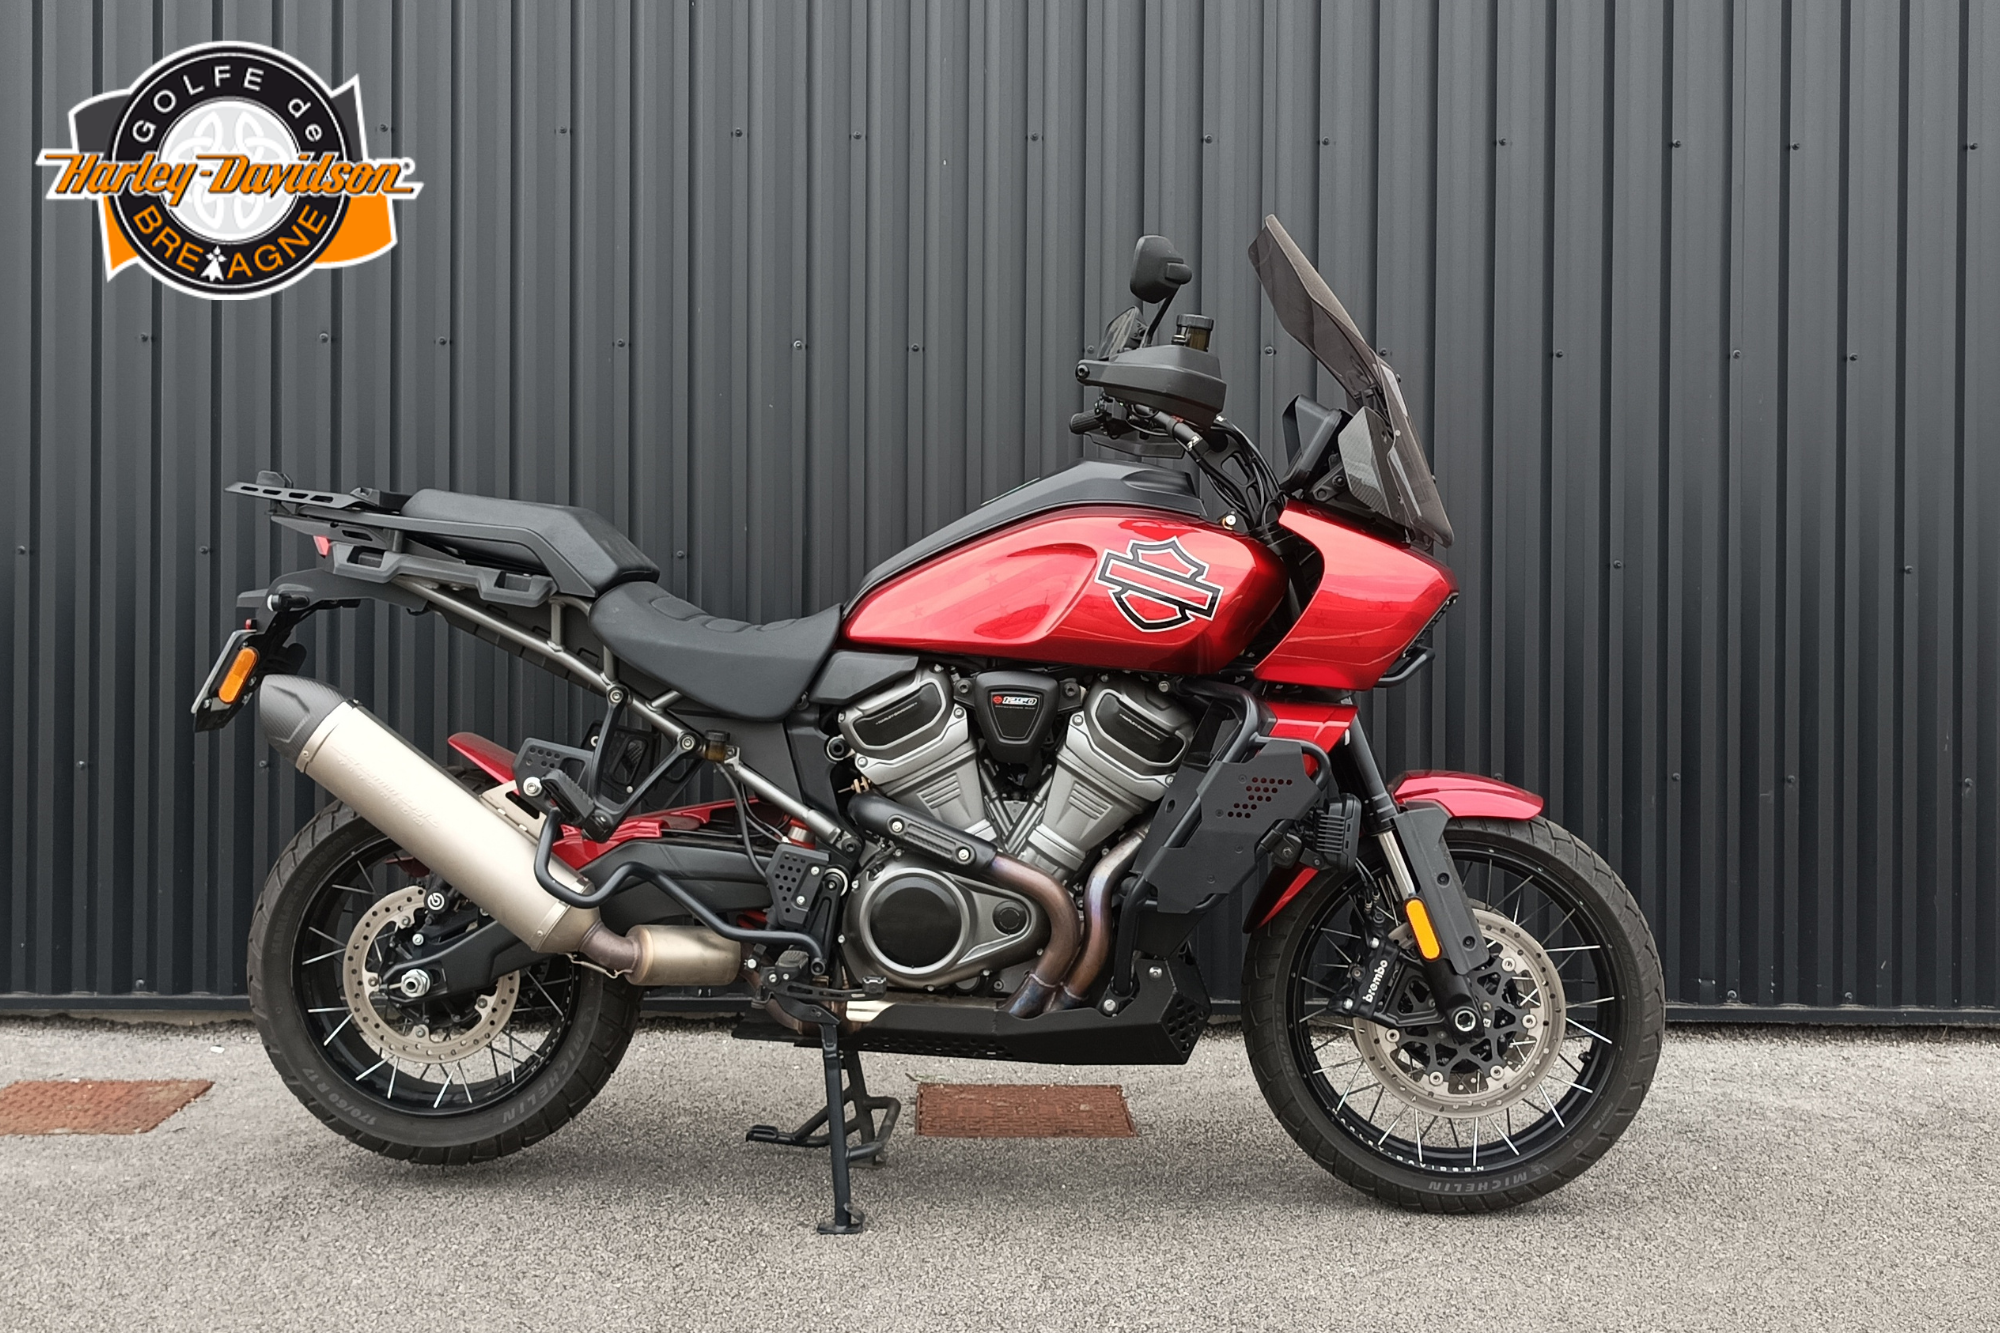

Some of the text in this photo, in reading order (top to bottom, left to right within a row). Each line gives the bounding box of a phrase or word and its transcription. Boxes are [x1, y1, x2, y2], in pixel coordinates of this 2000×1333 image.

[1362, 959, 1388, 1003] brembo
[301, 1067, 378, 1126] 170/60 R 17
[502, 1029, 585, 1124] MICHELIN
[1428, 1173, 1528, 1192] MICHELIN
